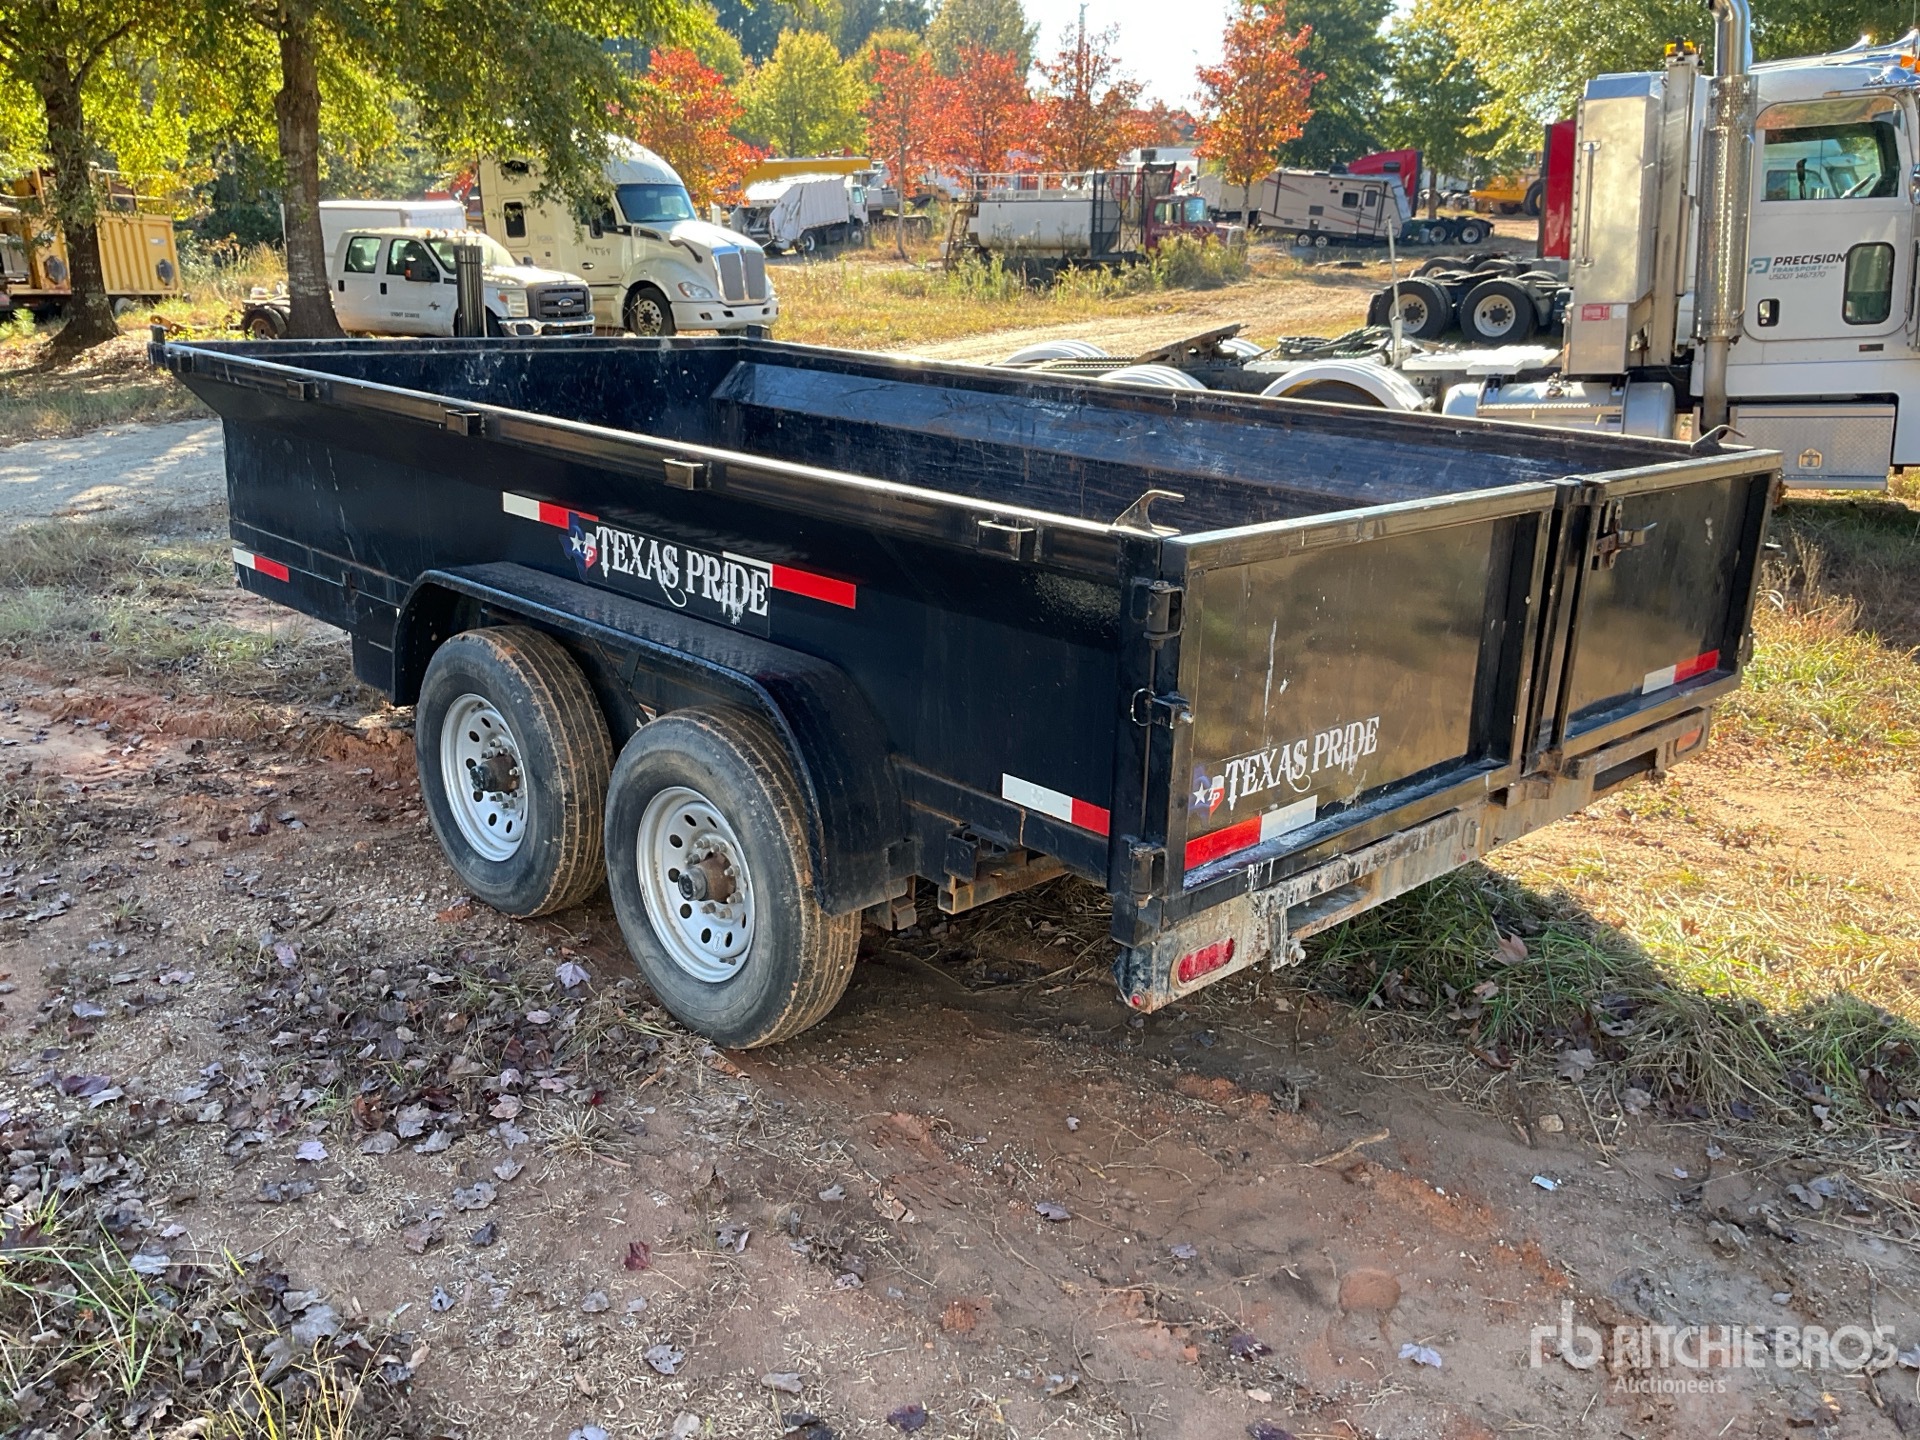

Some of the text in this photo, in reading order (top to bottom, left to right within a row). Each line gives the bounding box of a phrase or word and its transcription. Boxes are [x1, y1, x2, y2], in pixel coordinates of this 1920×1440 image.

[1772, 265, 1822, 273] TRANSPORT
[1773, 253, 1847, 266] PRECISION
[596, 526, 769, 626] TEXAS PRIDE
[1224, 715, 1380, 812] TEXAS PRIDE
